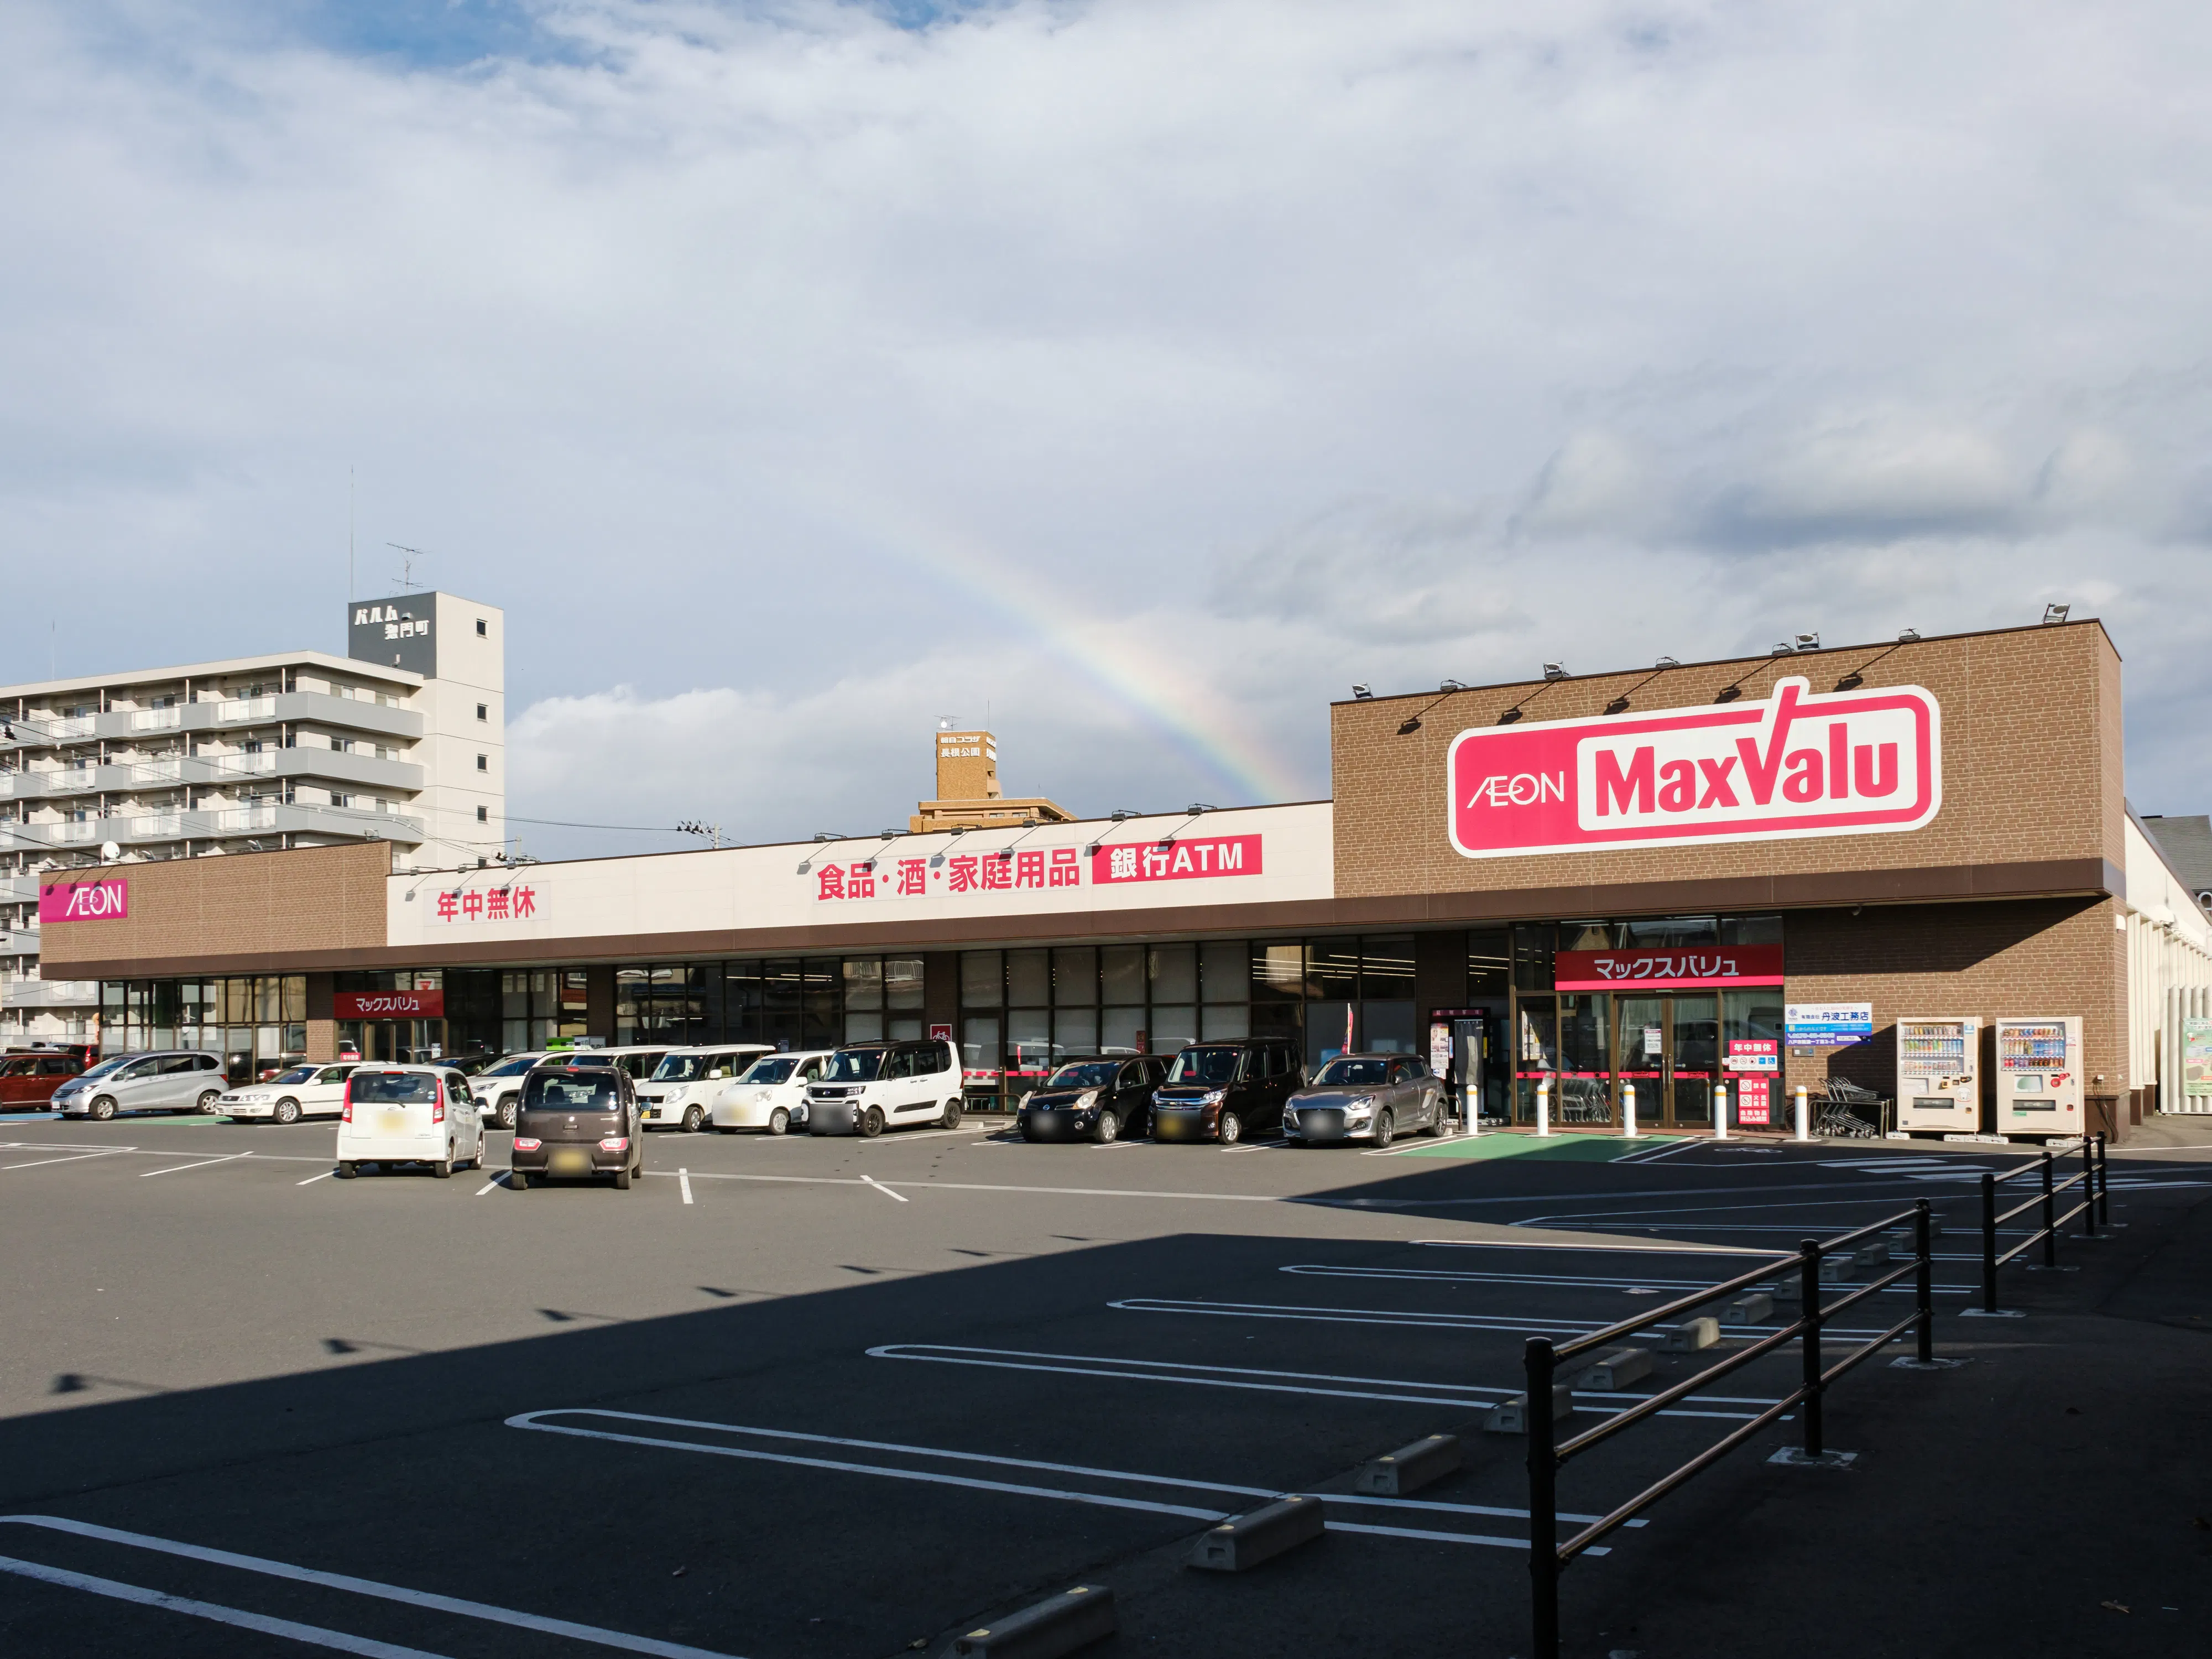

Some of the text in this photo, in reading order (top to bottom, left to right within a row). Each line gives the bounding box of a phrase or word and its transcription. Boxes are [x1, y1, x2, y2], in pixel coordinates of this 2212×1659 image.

[354, 606, 398, 625] パルム
[1595, 685, 1898, 817] MaxValu
[1110, 842, 1243, 879] 銀行ATM
[817, 848, 1079, 900] 食品・酒・家庭用品
[437, 885, 535, 922] 年中無休
[1594, 955, 1739, 979] マックスバリュ
[356, 997, 419, 1012] マックスバリュ
[1822, 1011, 1869, 1021] 丹波工務店
[1734, 1043, 1772, 1052] 年中無休
